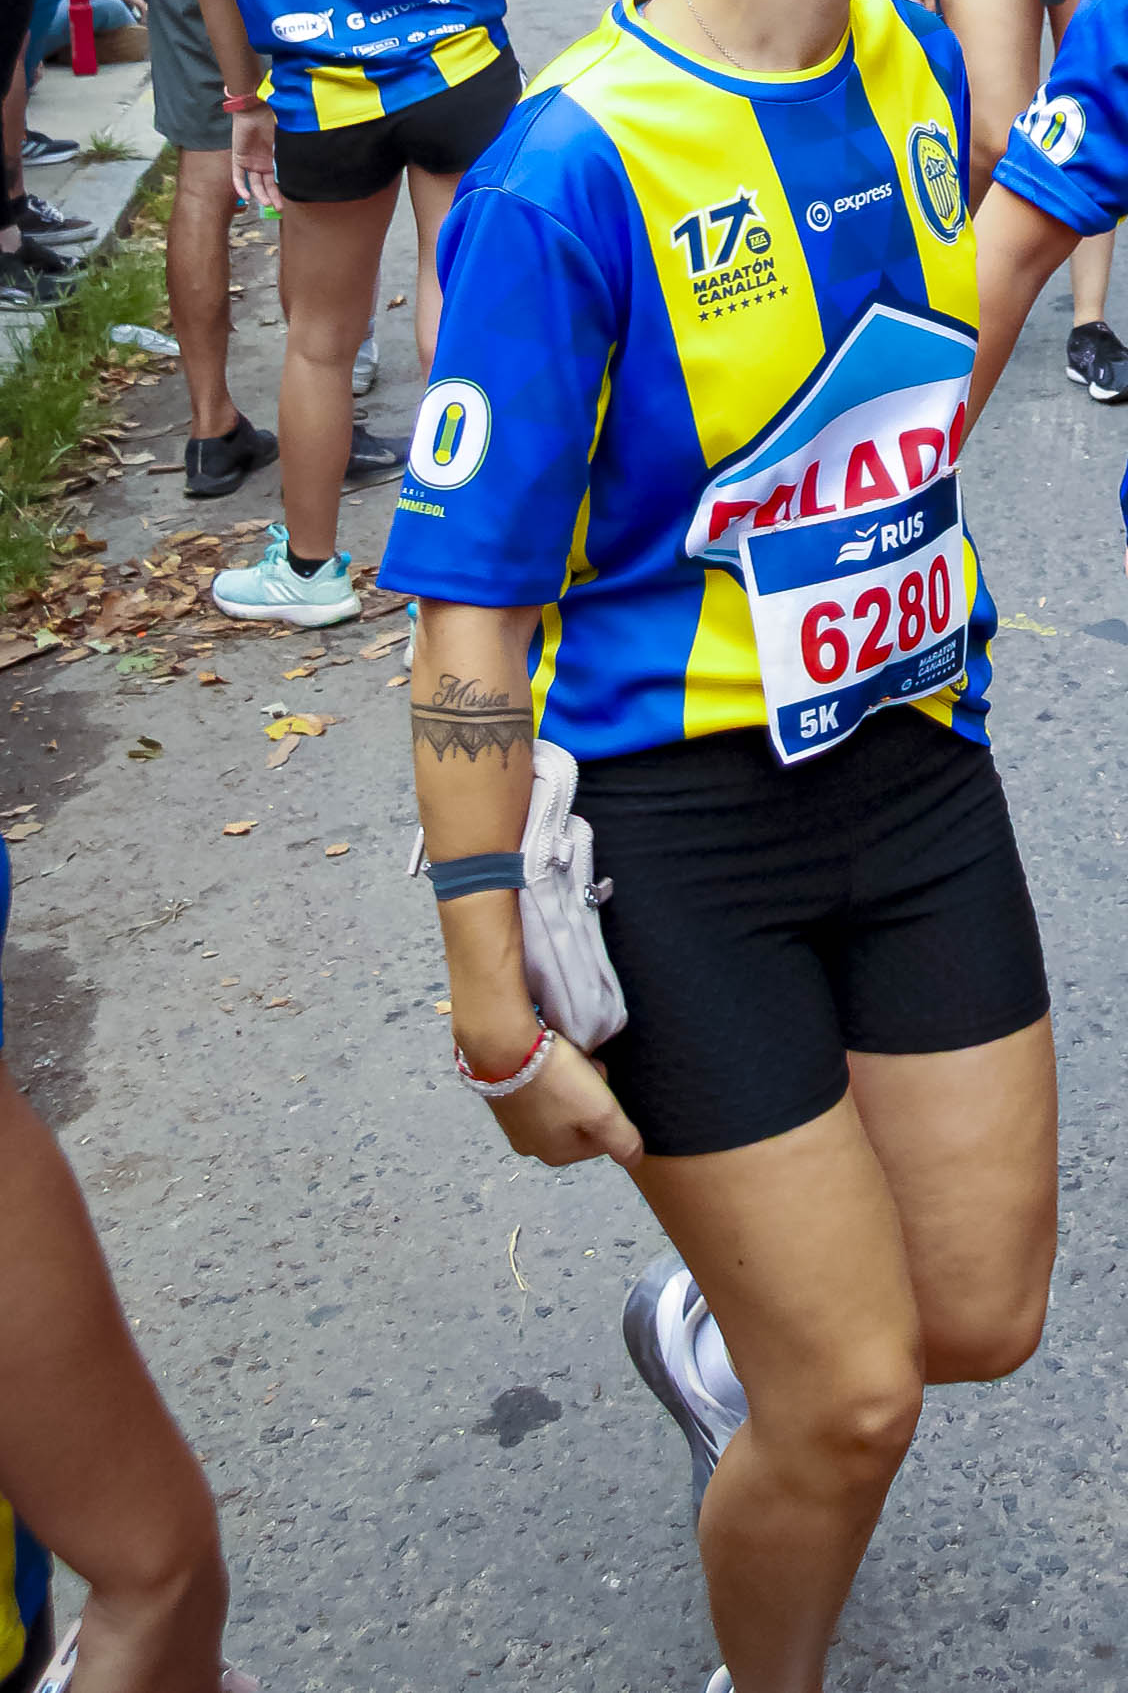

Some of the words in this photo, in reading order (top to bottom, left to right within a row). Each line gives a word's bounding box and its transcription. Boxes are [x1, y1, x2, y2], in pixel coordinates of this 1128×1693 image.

[834, 181, 893, 213] express
[670, 184, 767, 278] 17
[692, 257, 775, 295] MARATÓN
[697, 271, 778, 306] CANALLA
[880, 511, 925, 552] RUS
[801, 554, 951, 685] 6280
[800, 701, 841, 738] 5K
